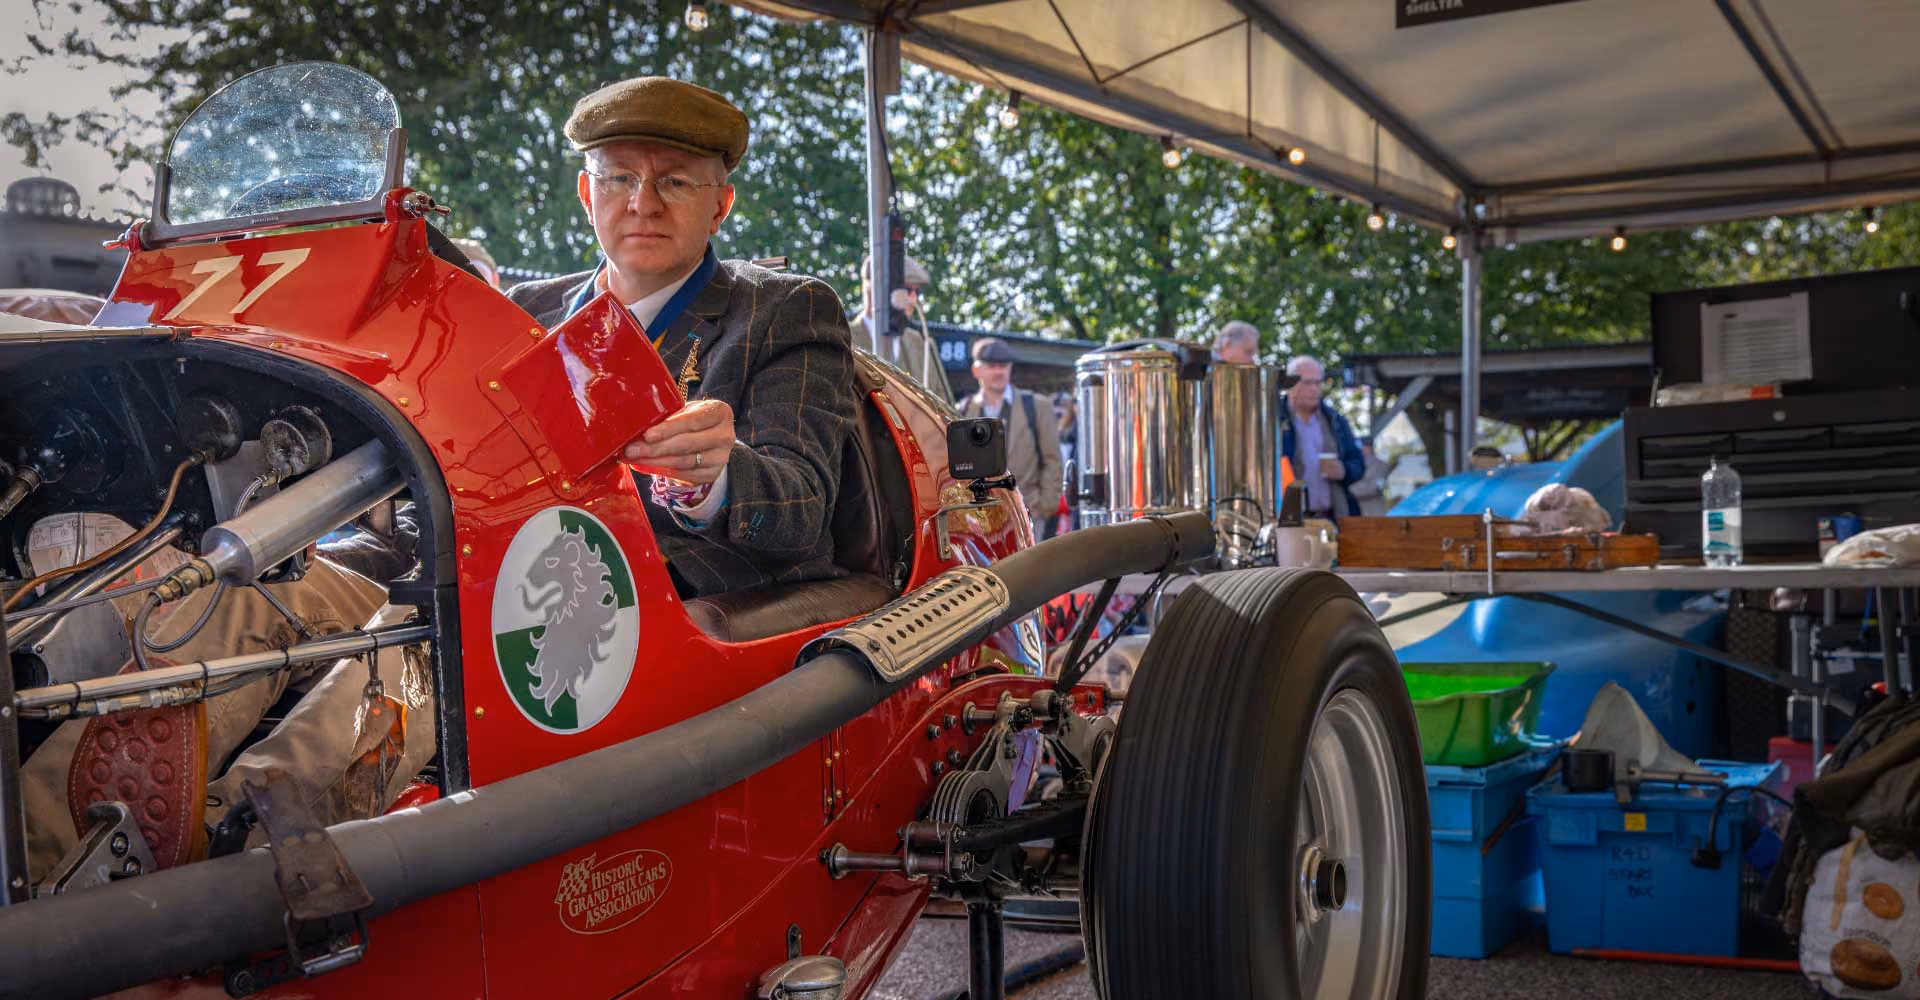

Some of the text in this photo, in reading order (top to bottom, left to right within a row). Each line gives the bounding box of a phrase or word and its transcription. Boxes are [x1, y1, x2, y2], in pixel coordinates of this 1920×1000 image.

[1405, 0, 1463, 16] SHELTER
[161, 247, 311, 320] 77
[941, 341, 966, 361] 88
[568, 862, 666, 917] GRAND PRIX CARS
[591, 854, 644, 889] HISTORIC
[585, 882, 656, 928] ASSOCIATION
